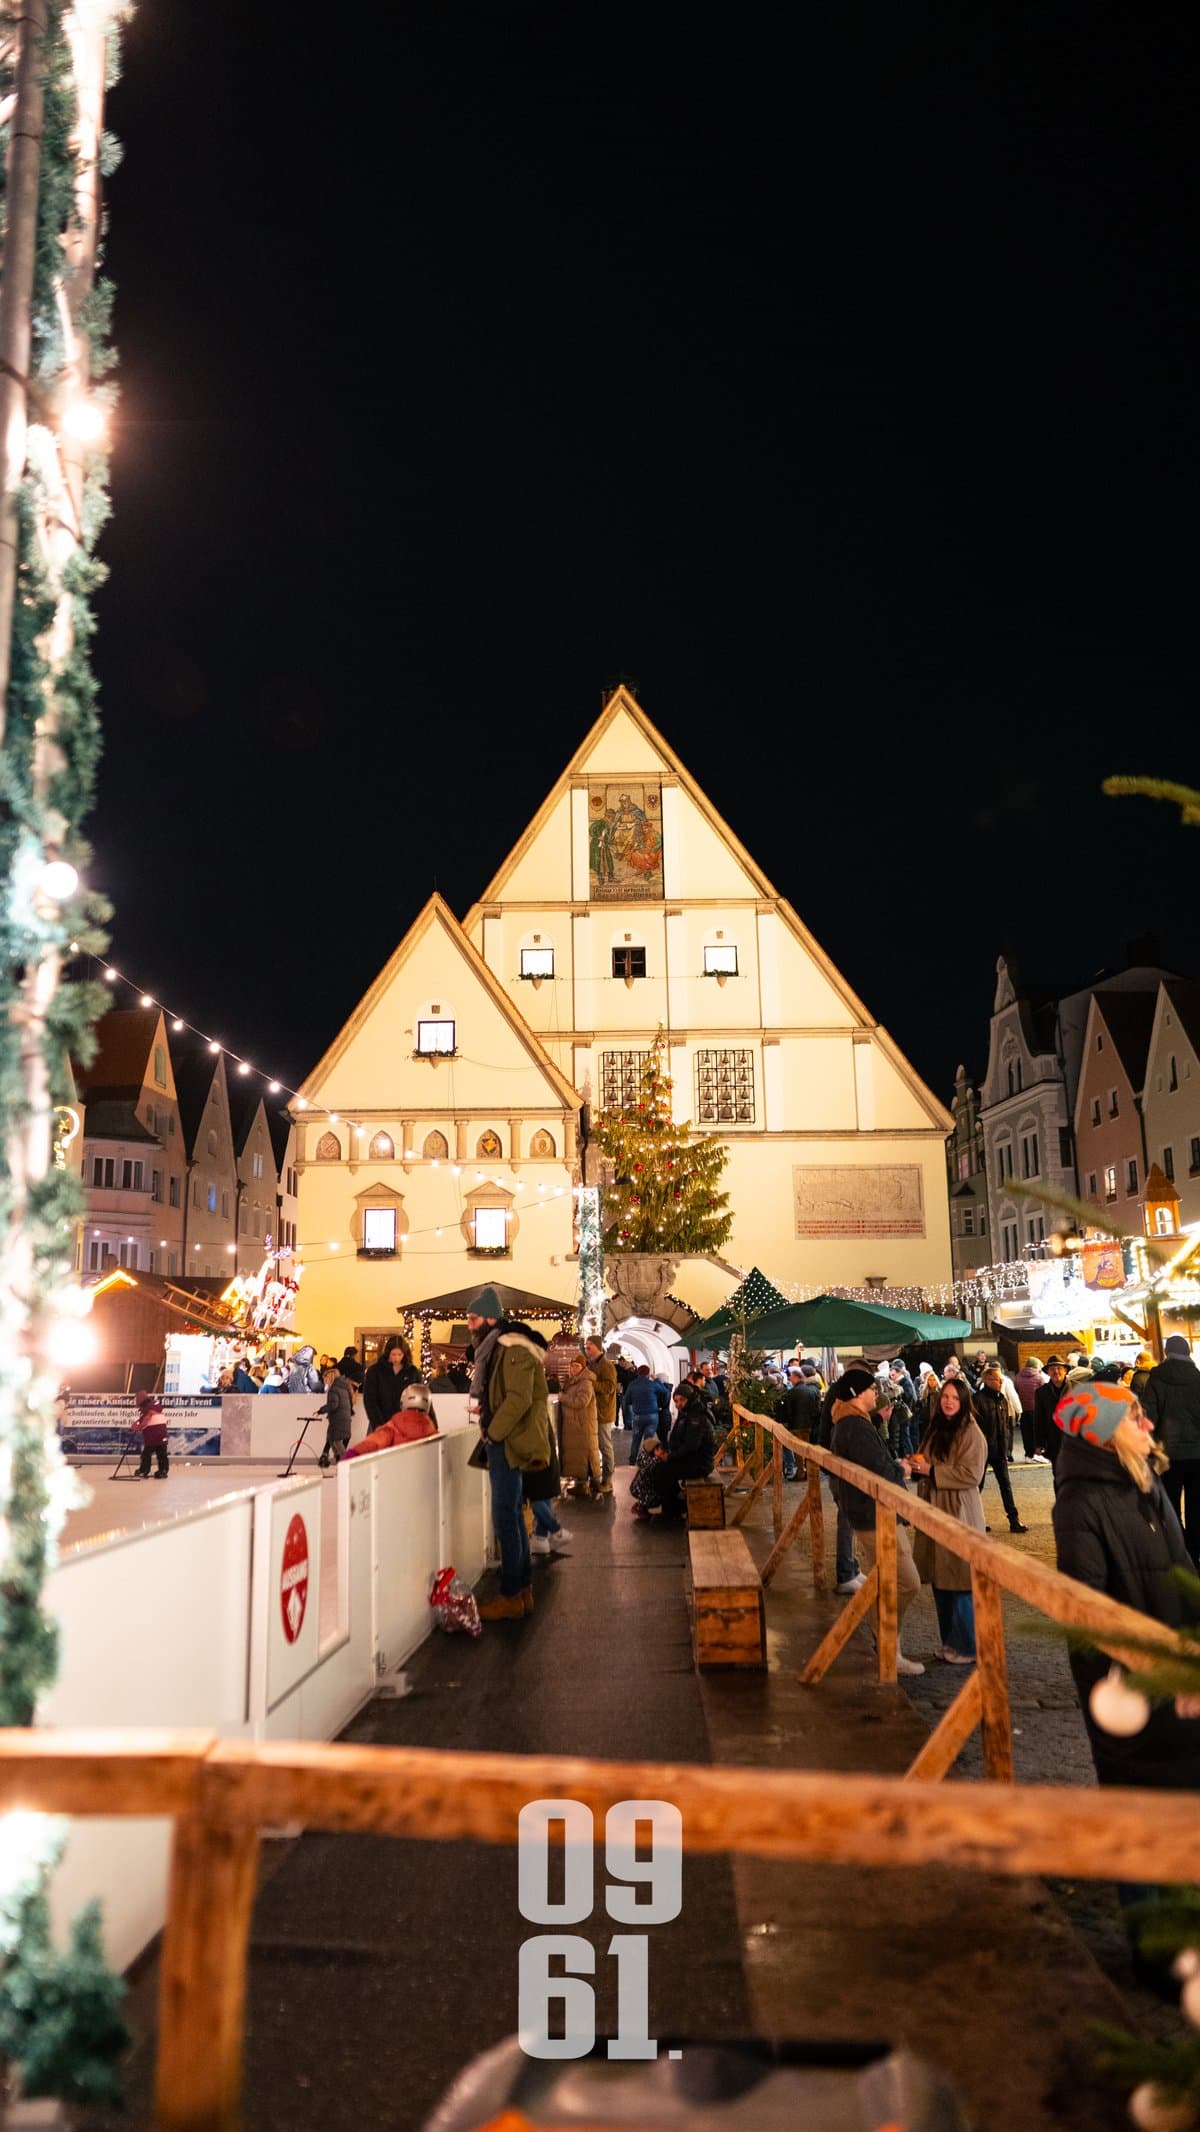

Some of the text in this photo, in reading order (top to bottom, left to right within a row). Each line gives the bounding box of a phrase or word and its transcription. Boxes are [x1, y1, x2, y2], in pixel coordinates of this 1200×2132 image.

[161, 1397, 174, 1406] für
[175, 1397, 189, 1406] Ihr
[190, 1397, 212, 1406] Event
